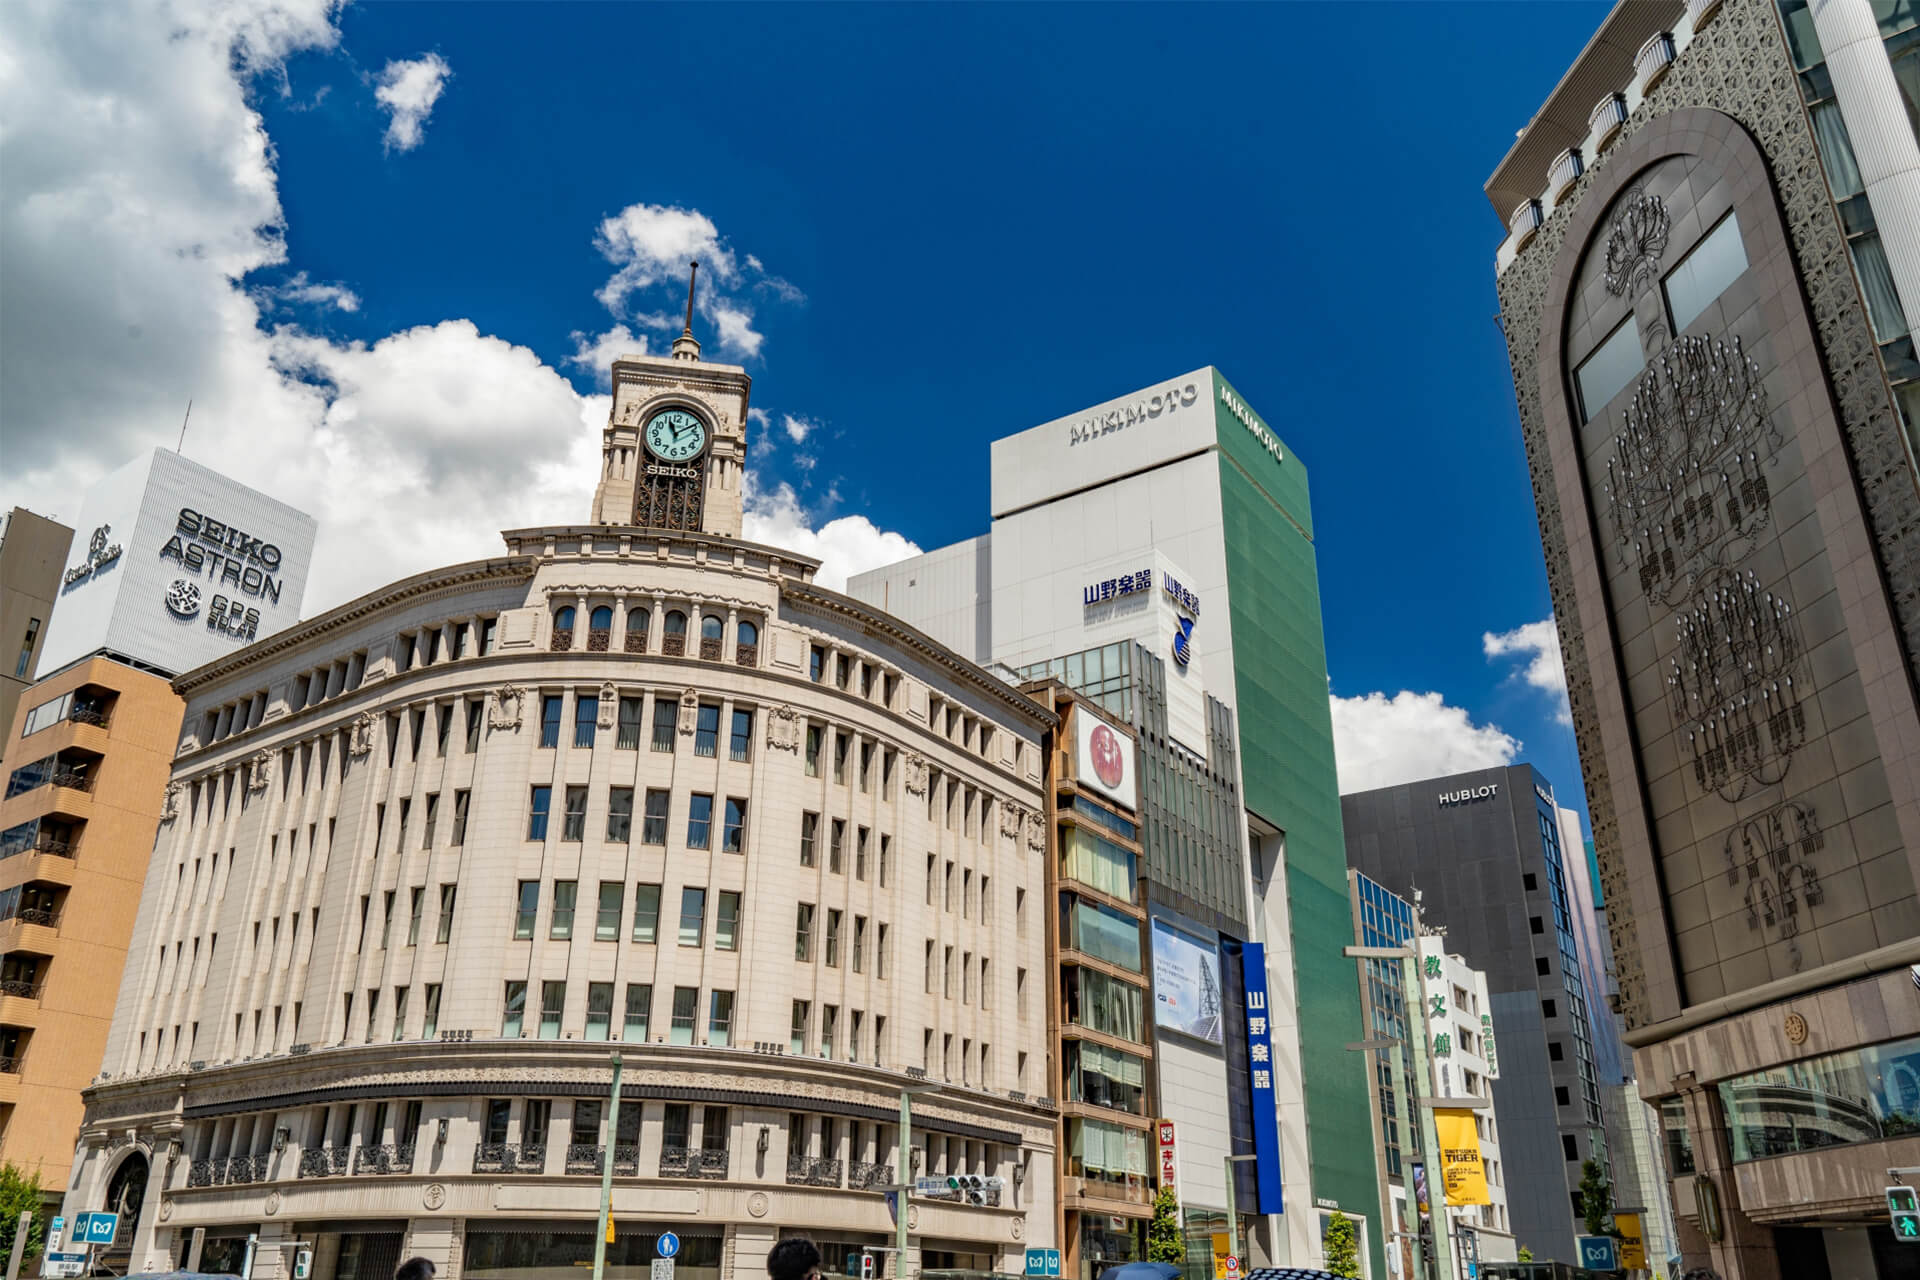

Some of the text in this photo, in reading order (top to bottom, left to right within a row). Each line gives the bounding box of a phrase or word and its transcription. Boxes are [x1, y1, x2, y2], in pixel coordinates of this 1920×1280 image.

[1070, 383, 1199, 446] MIKIMOTO
[1220, 384, 1283, 462] MIKIMOTO
[654, 438, 661, 446] 8
[662, 445, 669, 453] 7
[670, 448, 677, 456] 6
[681, 447, 687, 455] 5
[647, 465, 697, 478] SEIKO
[179, 508, 281, 566] SEIKO
[160, 535, 282, 600] ASTRON
[1084, 569, 1151, 605] 山野楽器
[1163, 571, 1200, 616] 山野楽器
[211, 594, 260, 624] GPS
[208, 611, 258, 638] SOLAR
[1439, 784, 1498, 805] HUBLOT
[1424, 955, 1451, 1057] 教文館
[1248, 992, 1270, 1088] 山野楽器
[1445, 1154, 1478, 1162] TIGER
